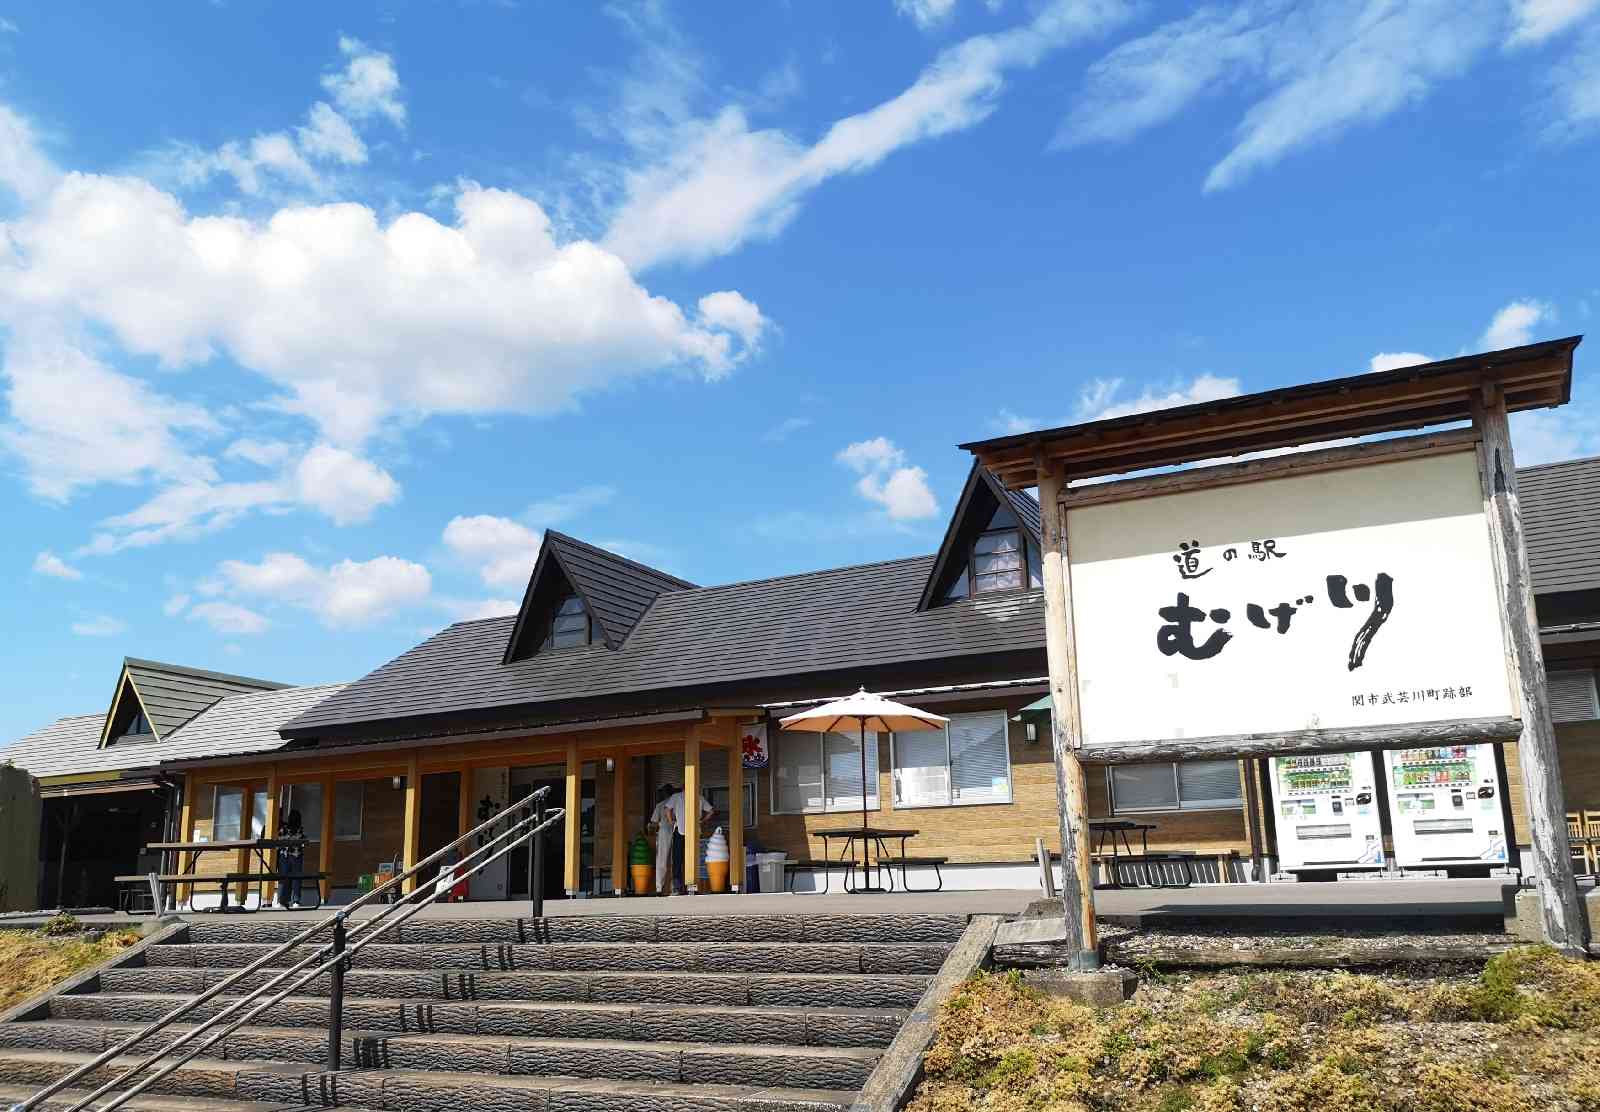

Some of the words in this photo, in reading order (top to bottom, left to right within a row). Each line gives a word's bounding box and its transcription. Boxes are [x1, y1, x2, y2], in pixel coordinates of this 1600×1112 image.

[1173, 540, 1287, 579] 道の駅
[1157, 573, 1394, 672] むげ川
